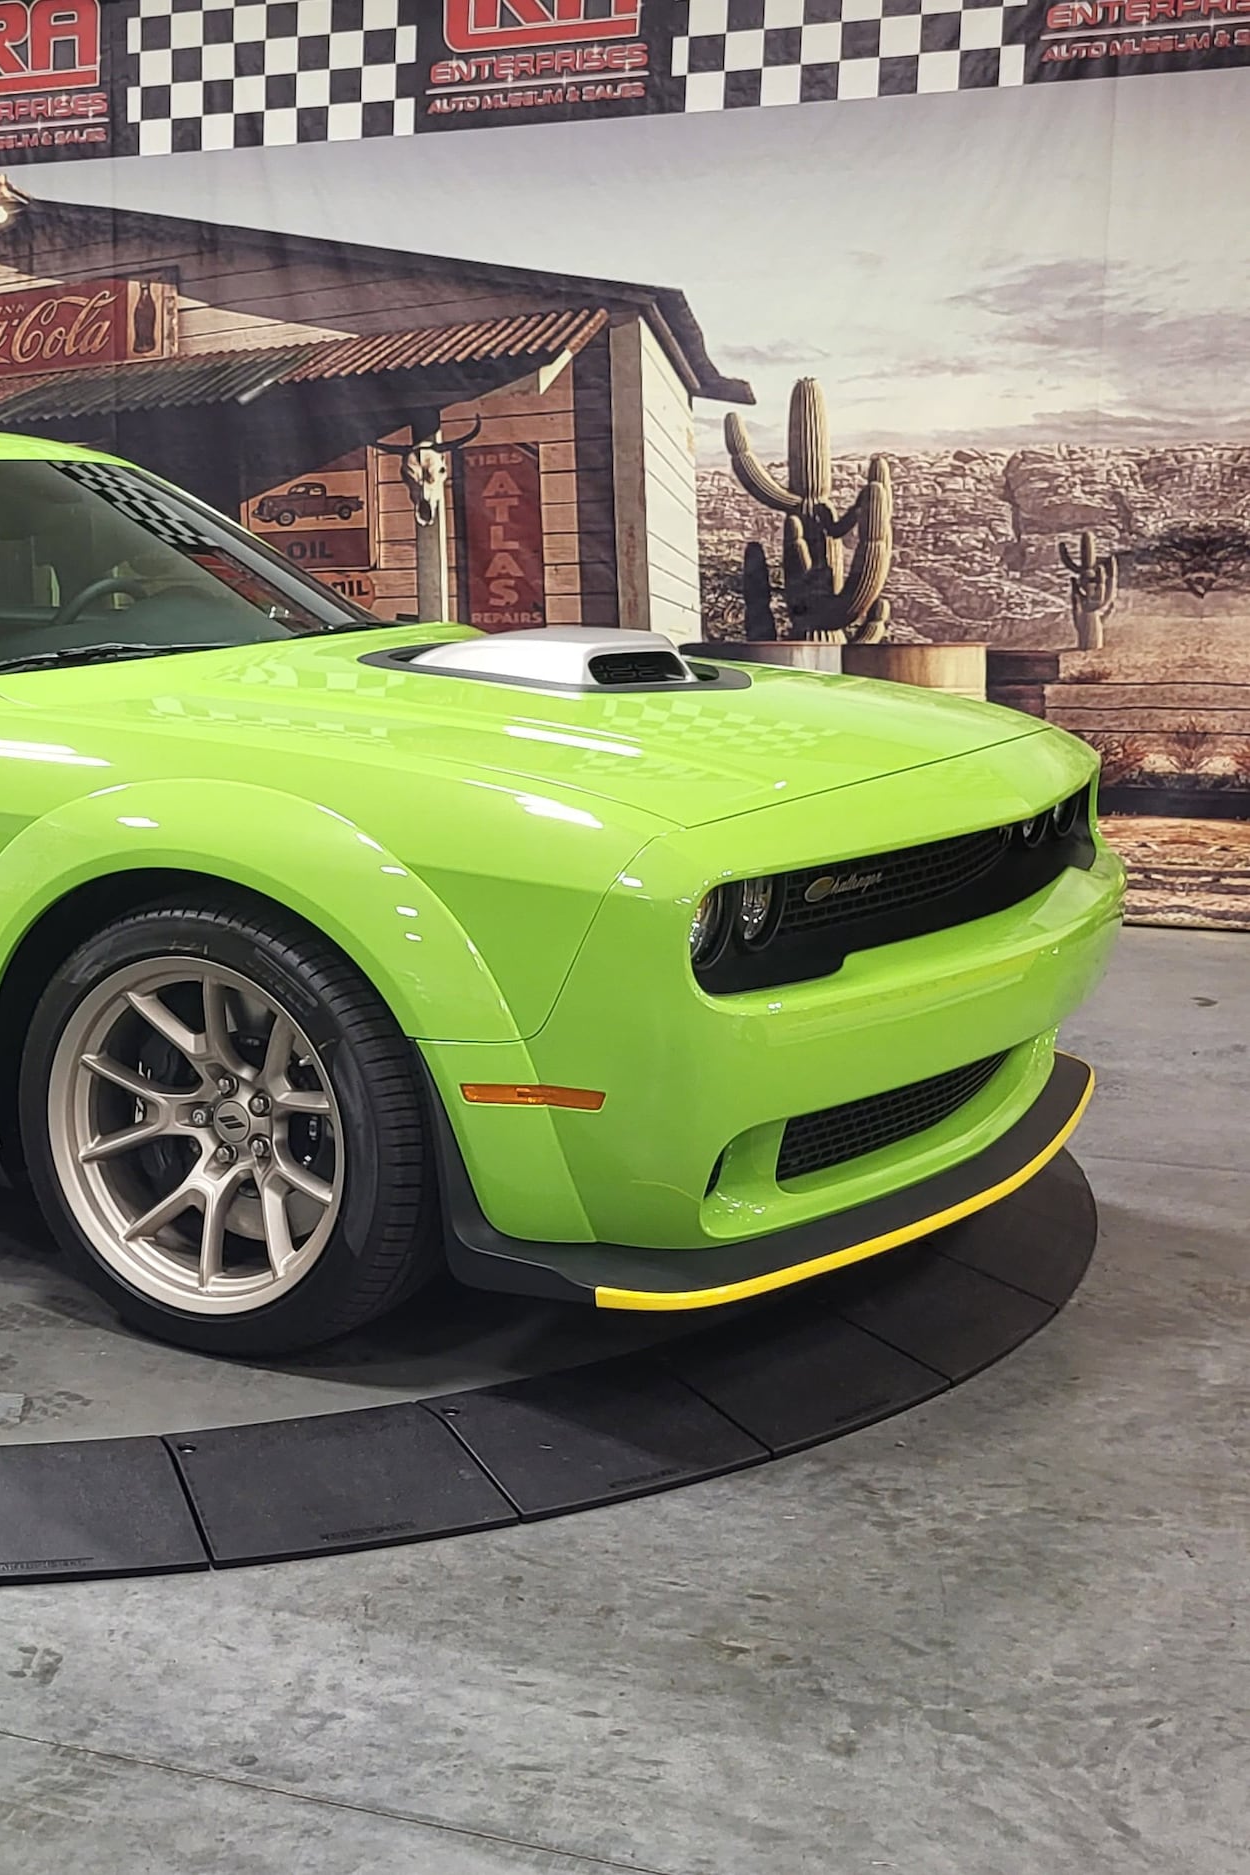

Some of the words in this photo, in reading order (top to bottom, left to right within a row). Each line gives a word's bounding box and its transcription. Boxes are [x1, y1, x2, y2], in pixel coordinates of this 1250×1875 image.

[1040, 42, 1106, 62] AUTO
[1108, 33, 1210, 57] MUSEUM
[1213, 29, 1231, 48] &
[430, 43, 649, 84] ENTERPRISES
[427, 96, 480, 115] AUTO
[480, 89, 563, 110] MUSEUM
[565, 86, 580, 104] &
[581, 82, 645, 101] SALES
[40, 131, 53, 146] &
[53, 127, 107, 145] SALES
[466, 452, 524, 467] TIRES
[286, 540, 335, 560] OIL
[481, 469, 525, 607] ATLAS
[471, 611, 543, 625] REPAIRS
[803, 872, 883, 904] Challenger
